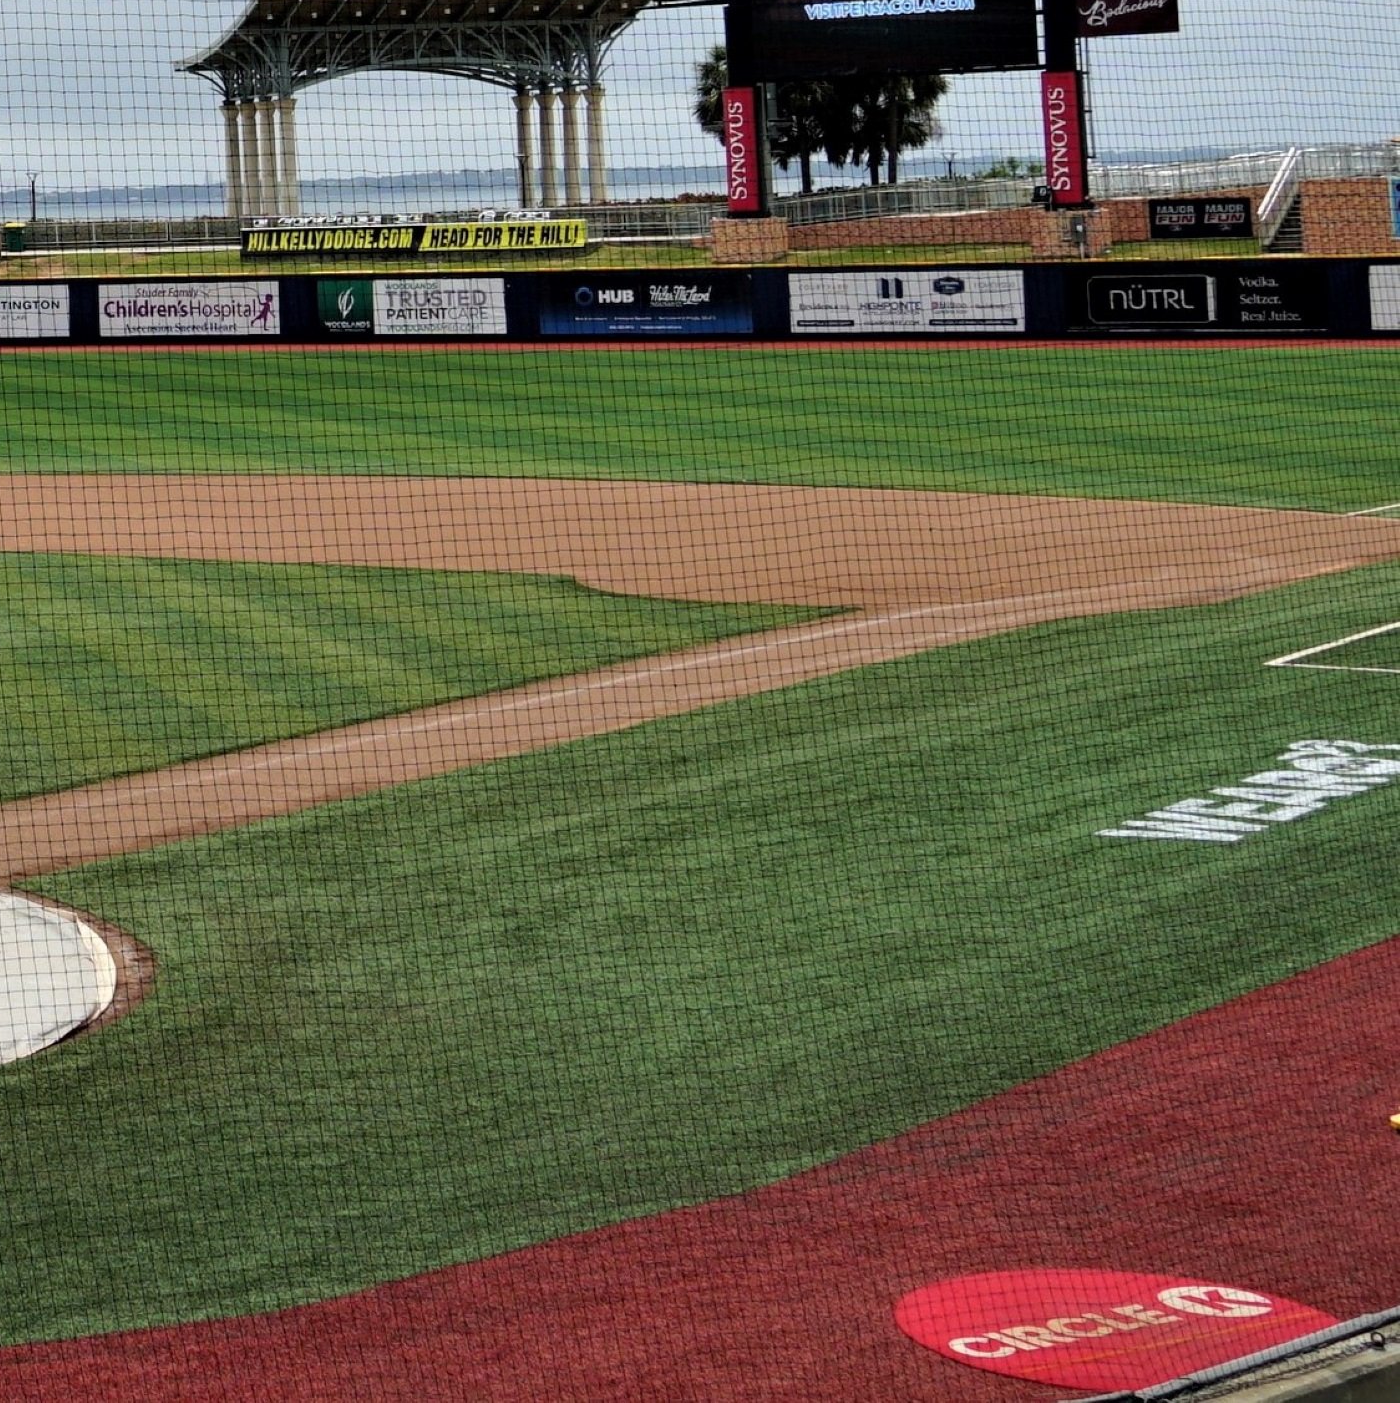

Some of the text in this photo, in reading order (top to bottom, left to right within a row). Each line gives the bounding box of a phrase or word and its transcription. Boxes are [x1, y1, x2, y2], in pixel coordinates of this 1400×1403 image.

[1047, 87, 1071, 190] SYNOVUS
[728, 101, 748, 200] SYNOVUS
[1156, 206, 1195, 214] MAJOR
[1205, 204, 1244, 213] MAJOR
[1157, 215, 1194, 224] FUN
[1206, 213, 1243, 223] FUN
[248, 228, 413, 252] HILLKELLYDODGE.COM
[430, 224, 580, 248] HEAD FOR THE HILL!
[385, 282, 438, 290] WOODLANDS
[1239, 277, 1279, 287] Vodka.
[136, 287, 199, 298] Studer Family
[598, 290, 635, 303] HUB
[385, 290, 487, 307] TRUSTED
[1240, 294, 1282, 304] Seltzer.
[1241, 310, 1266, 321] Real
[948, 1287, 1273, 1359] CIRCLE K
